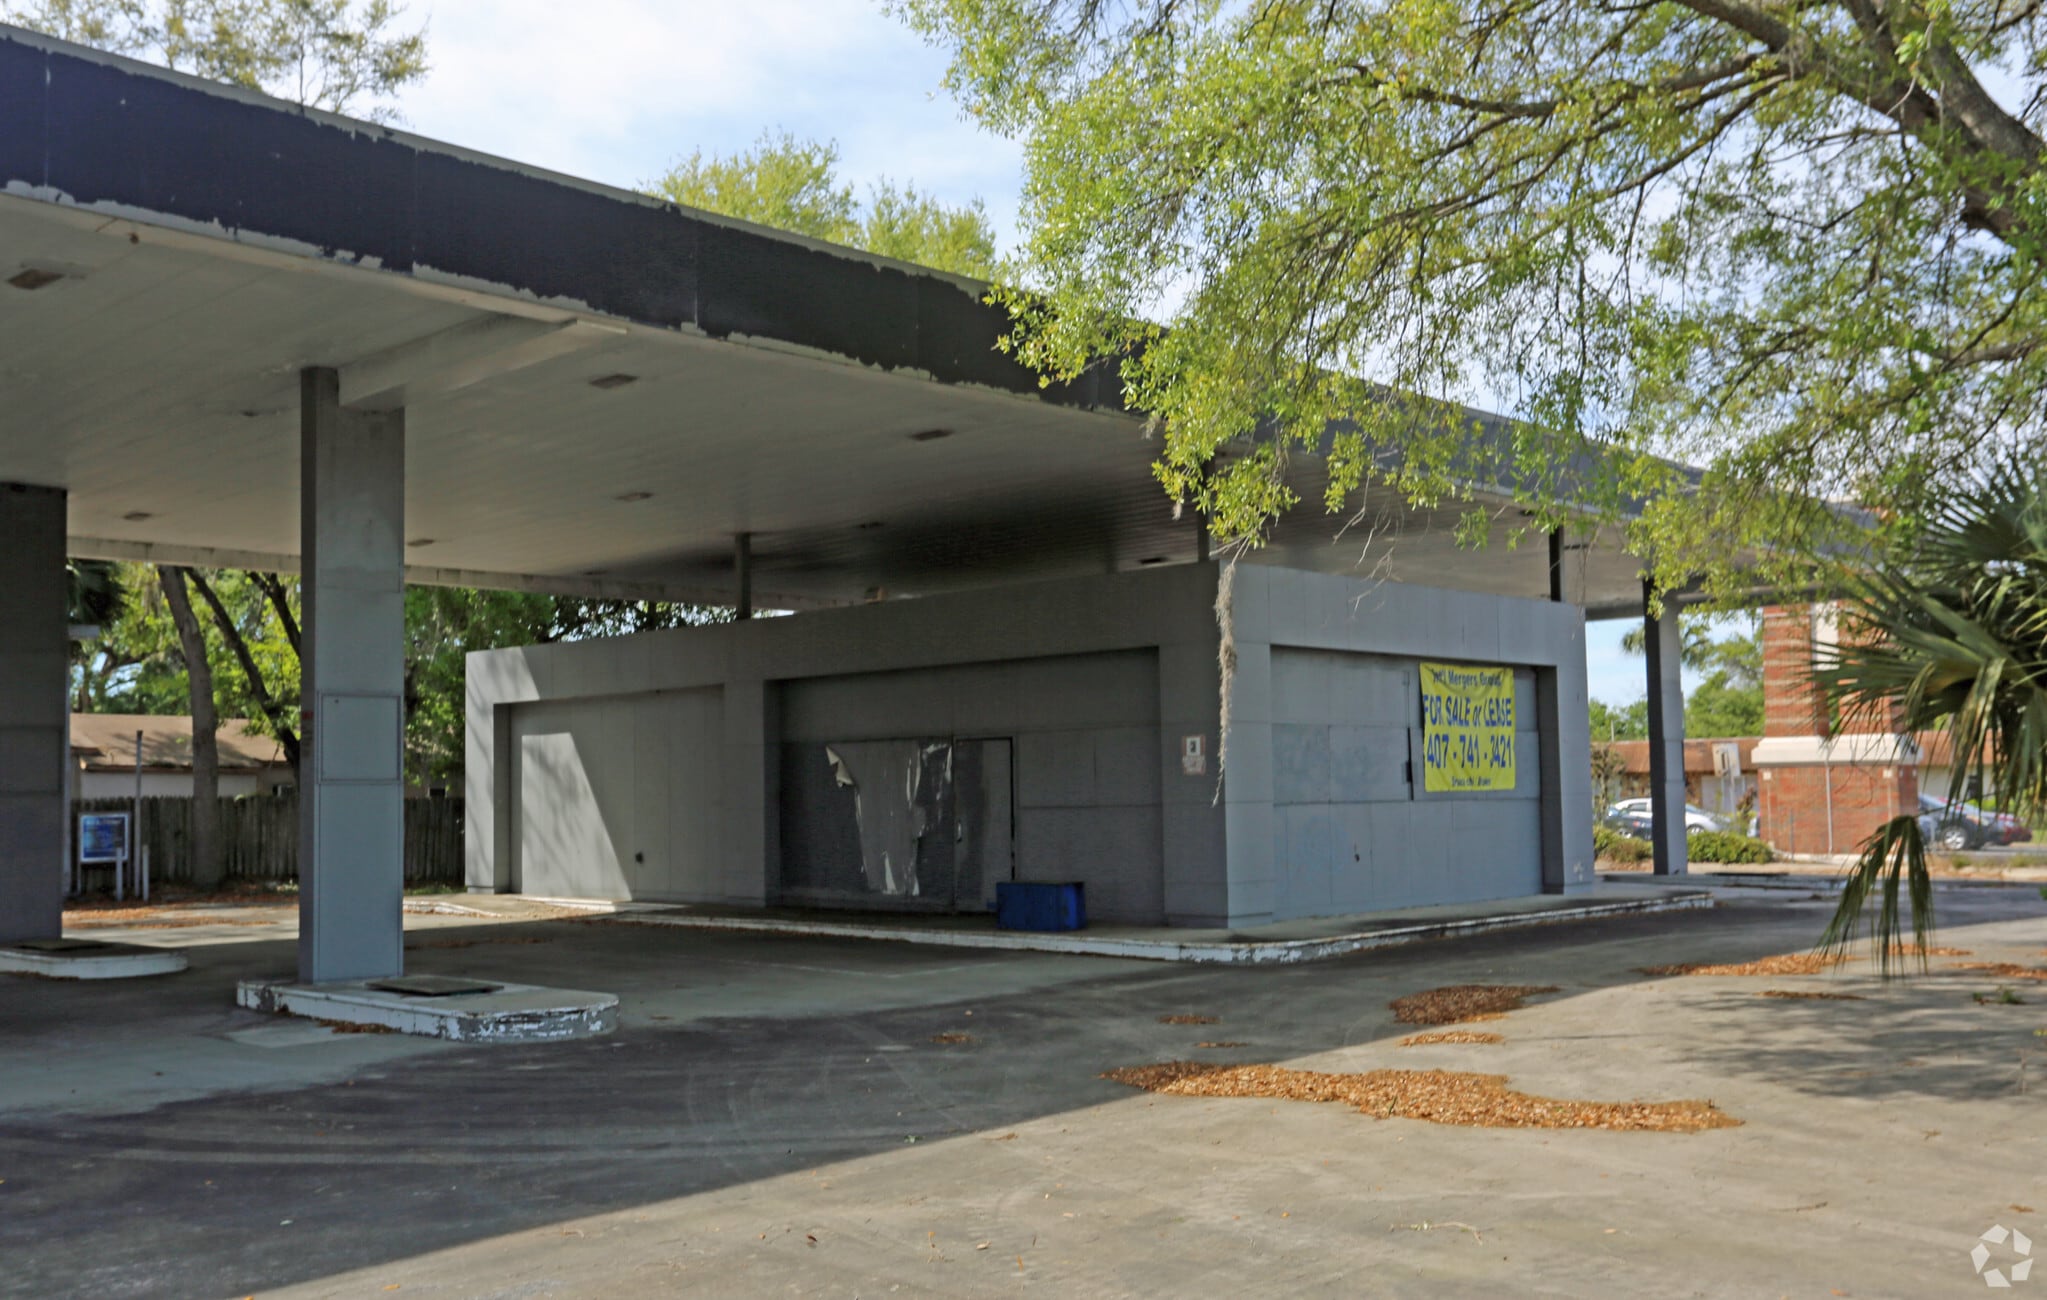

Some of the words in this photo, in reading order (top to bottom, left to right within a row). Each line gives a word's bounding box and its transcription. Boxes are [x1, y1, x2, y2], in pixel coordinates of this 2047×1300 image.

[1423, 694, 1444, 726] FOR
[1445, 695, 1471, 727] SALE
[1472, 705, 1482, 727] or
[1483, 697, 1512, 727] LEASE
[1427, 733, 1449, 768] 407
[1459, 734, 1480, 768] 741
